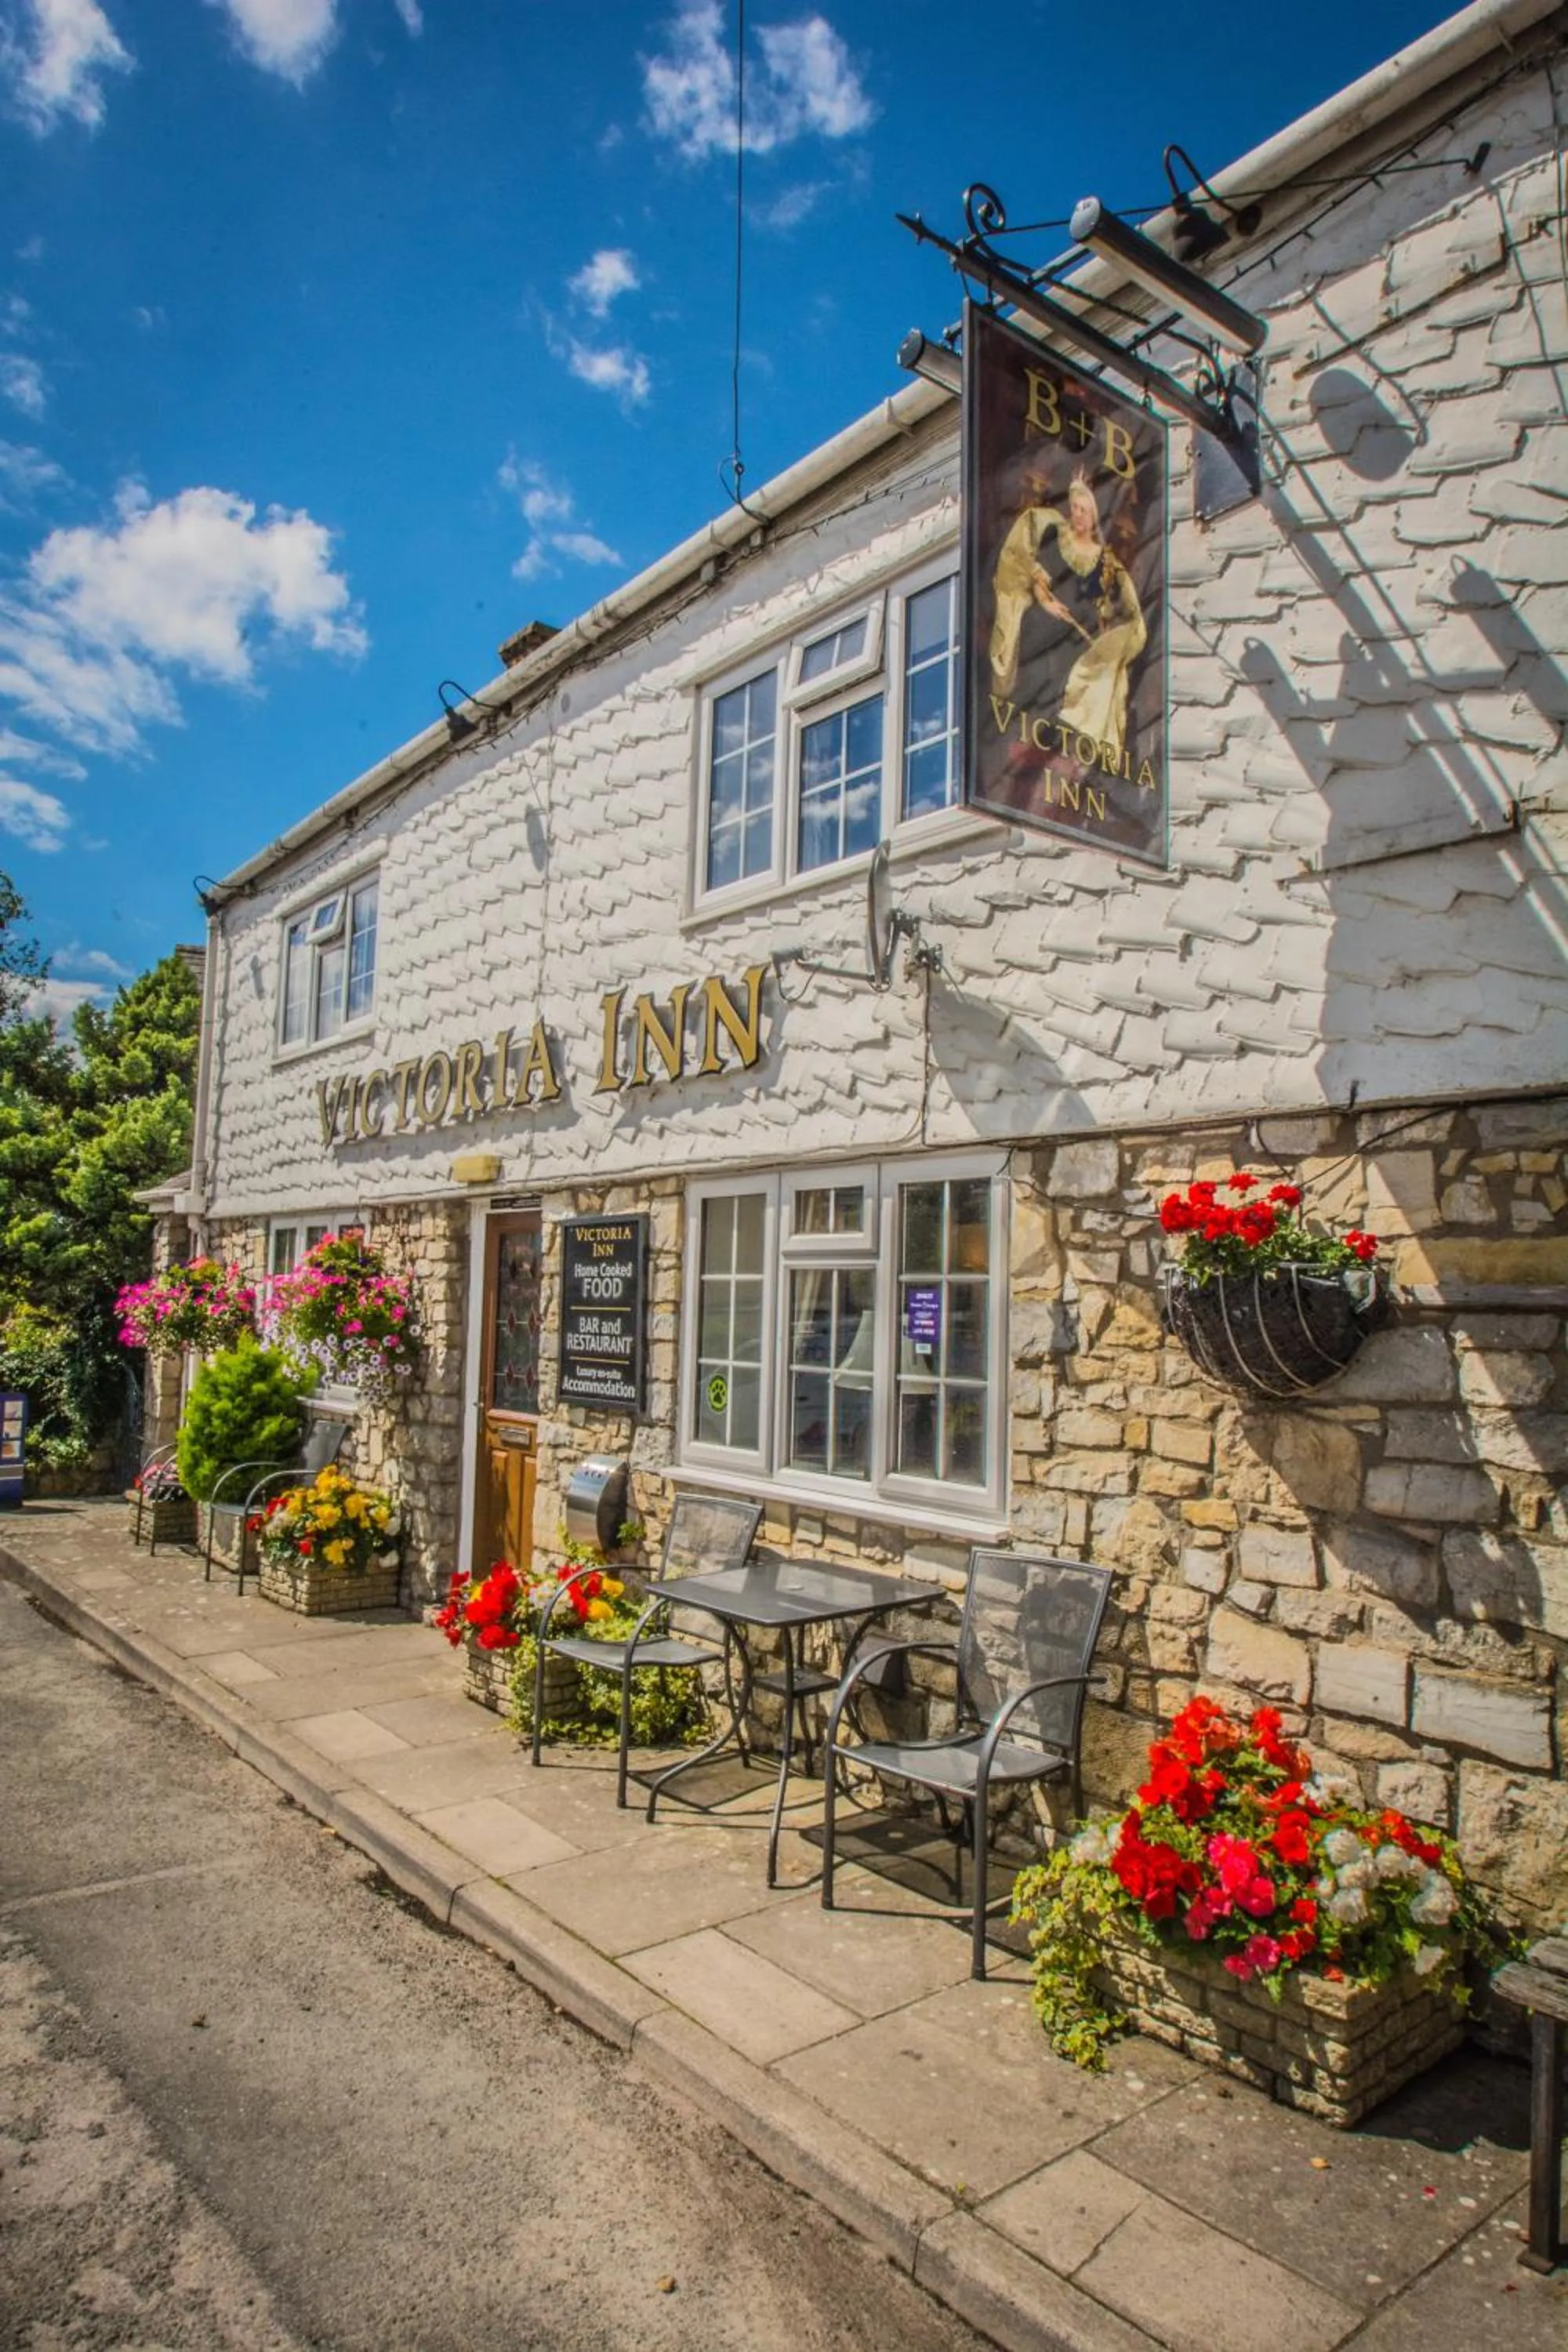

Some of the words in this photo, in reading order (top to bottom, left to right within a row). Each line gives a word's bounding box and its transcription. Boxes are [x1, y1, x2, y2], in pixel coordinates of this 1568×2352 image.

[989, 694, 1155, 790] VICTORIA
[1044, 768, 1105, 821] INN
[316, 1017, 561, 1147] VICTORIA
[593, 962, 771, 1095] INN
[575, 1226, 631, 1241] VICTORIA
[593, 1243, 614, 1257] INN
[575, 1263, 598, 1278] Home
[600, 1261, 633, 1277] Cooked
[583, 1278, 622, 1299] FOOD
[580, 1317, 599, 1333] BAR
[601, 1318, 621, 1334] and
[567, 1333, 633, 1354] RESTAURANT
[563, 1376, 635, 1399] Accommodation
